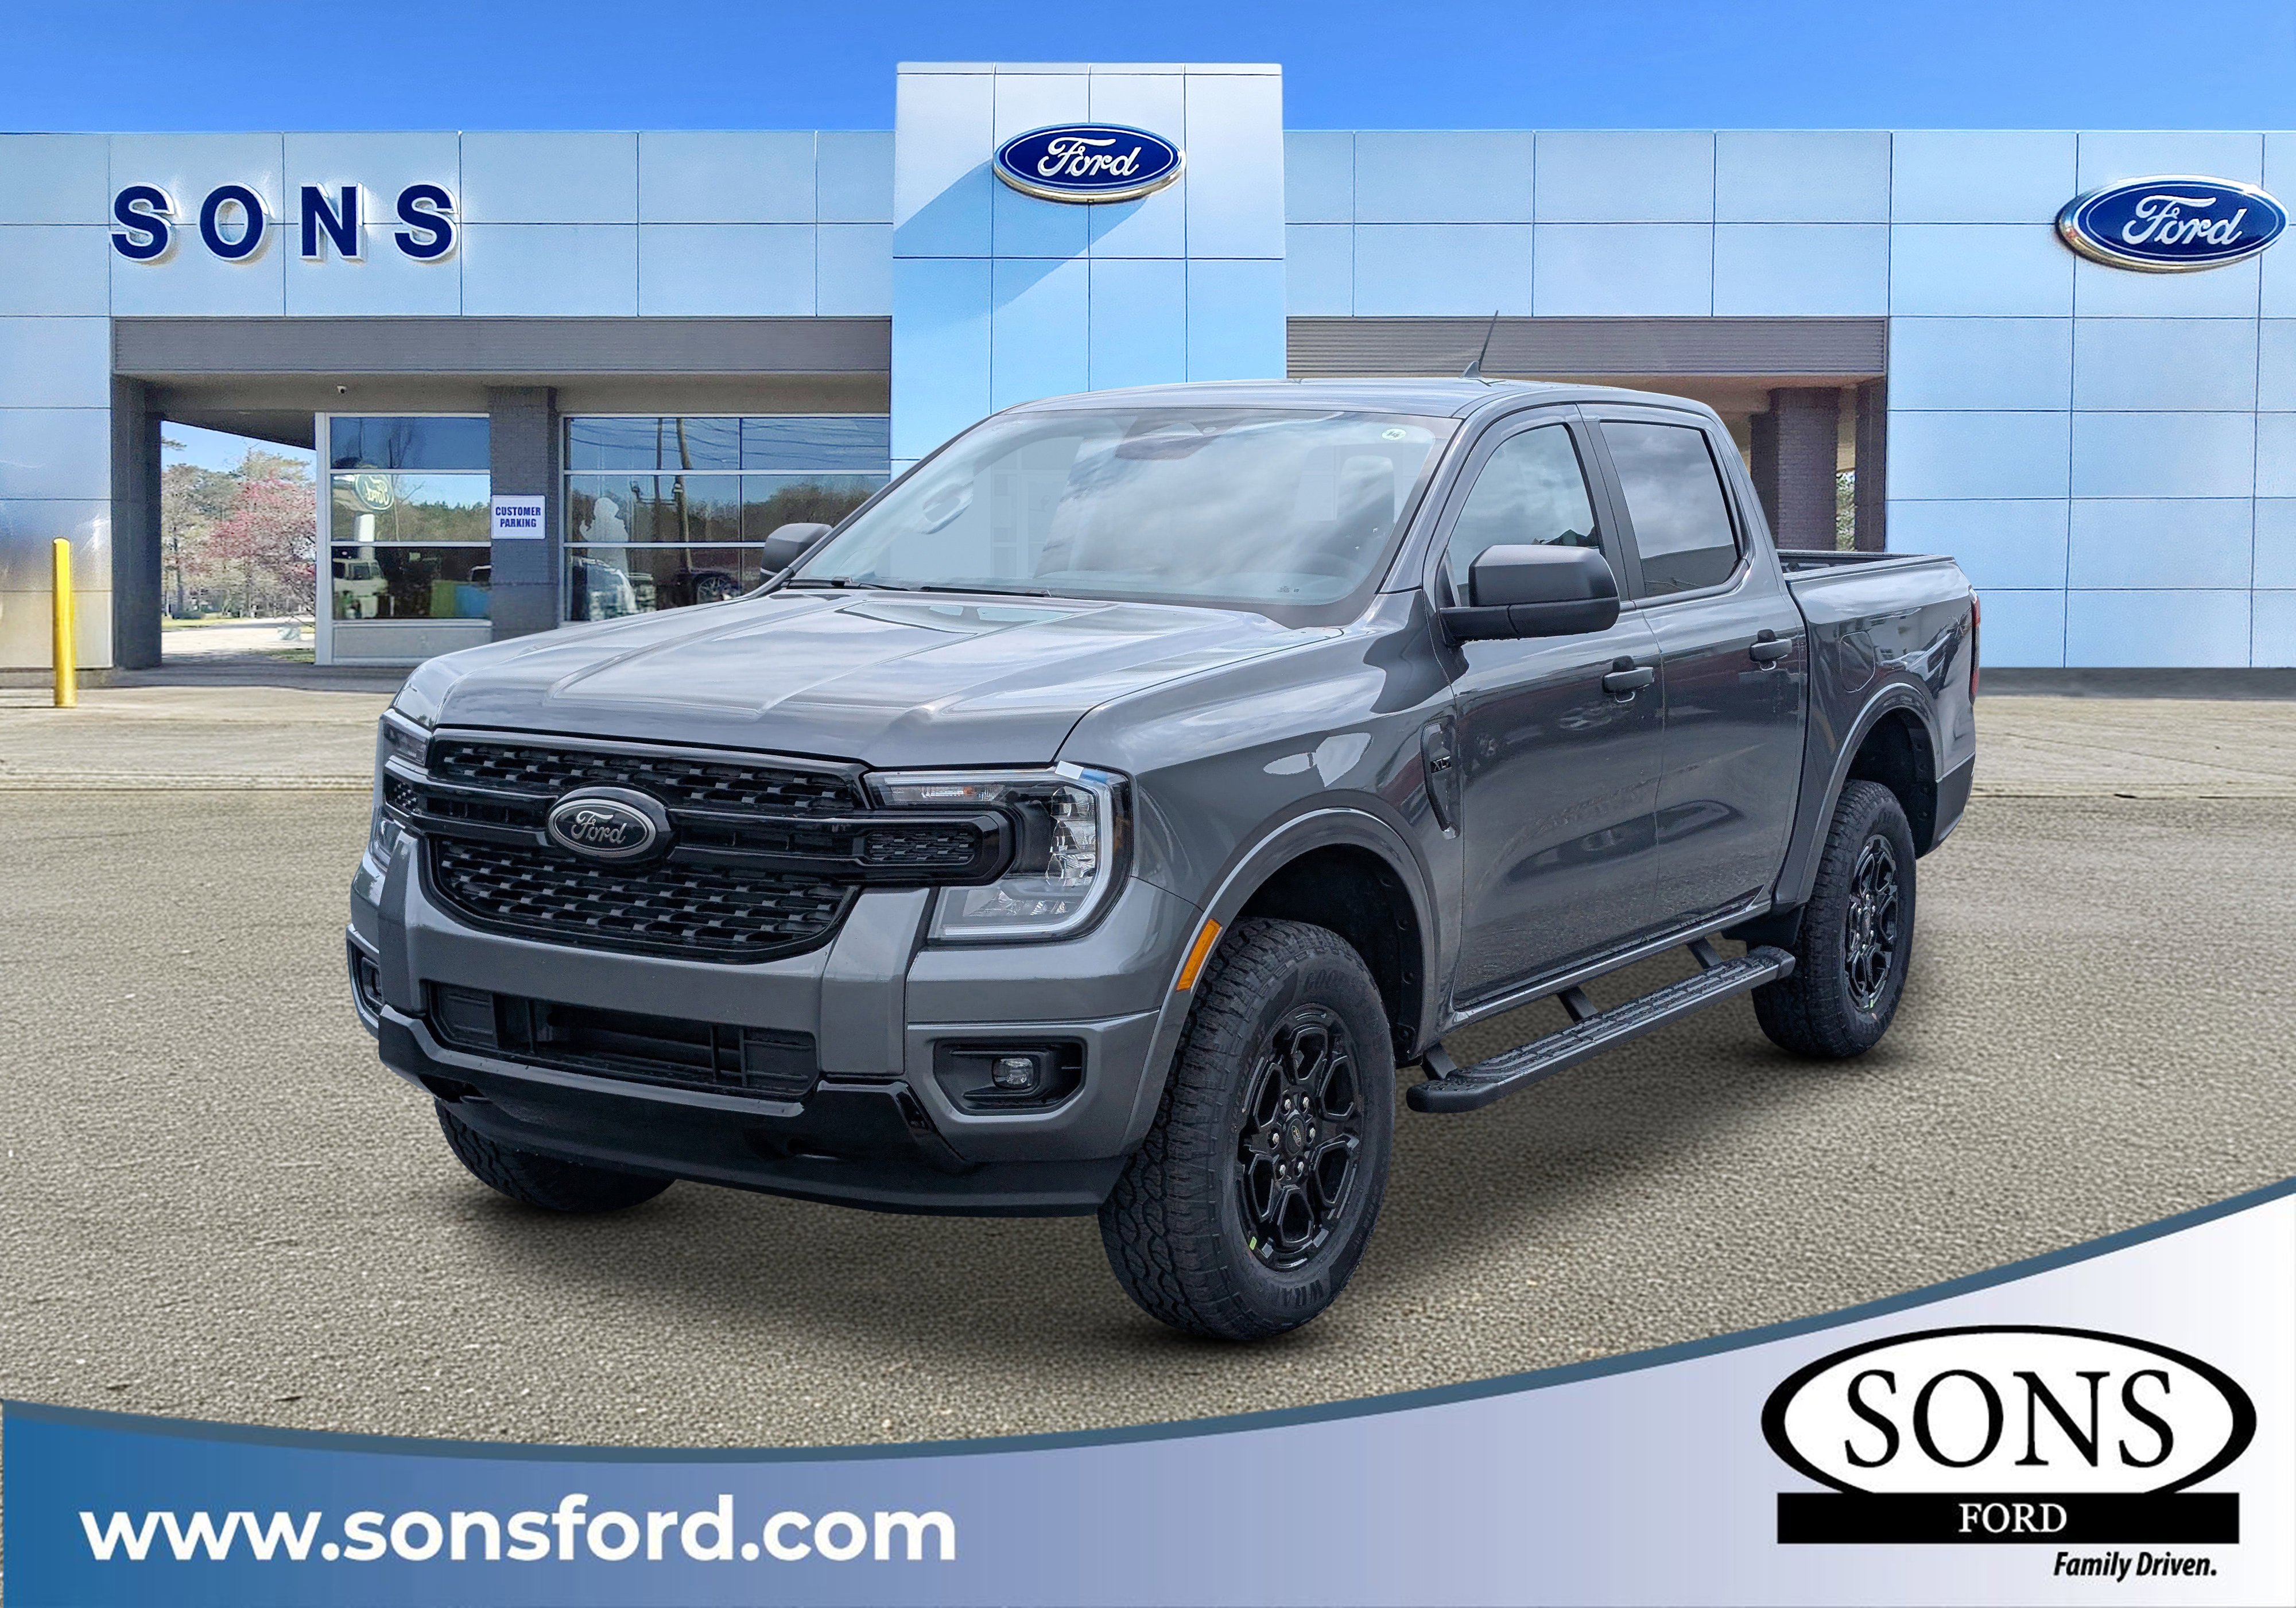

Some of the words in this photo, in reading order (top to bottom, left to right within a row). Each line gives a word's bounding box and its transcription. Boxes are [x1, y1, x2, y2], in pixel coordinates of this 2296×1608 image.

[1037, 136, 1142, 177] Ford
[109, 184, 458, 260] SONS
[2122, 195, 2247, 245] Ford
[495, 506, 541, 516] CUSTOMER
[500, 518, 537, 527] PARKING
[571, 810, 627, 844] Ford
